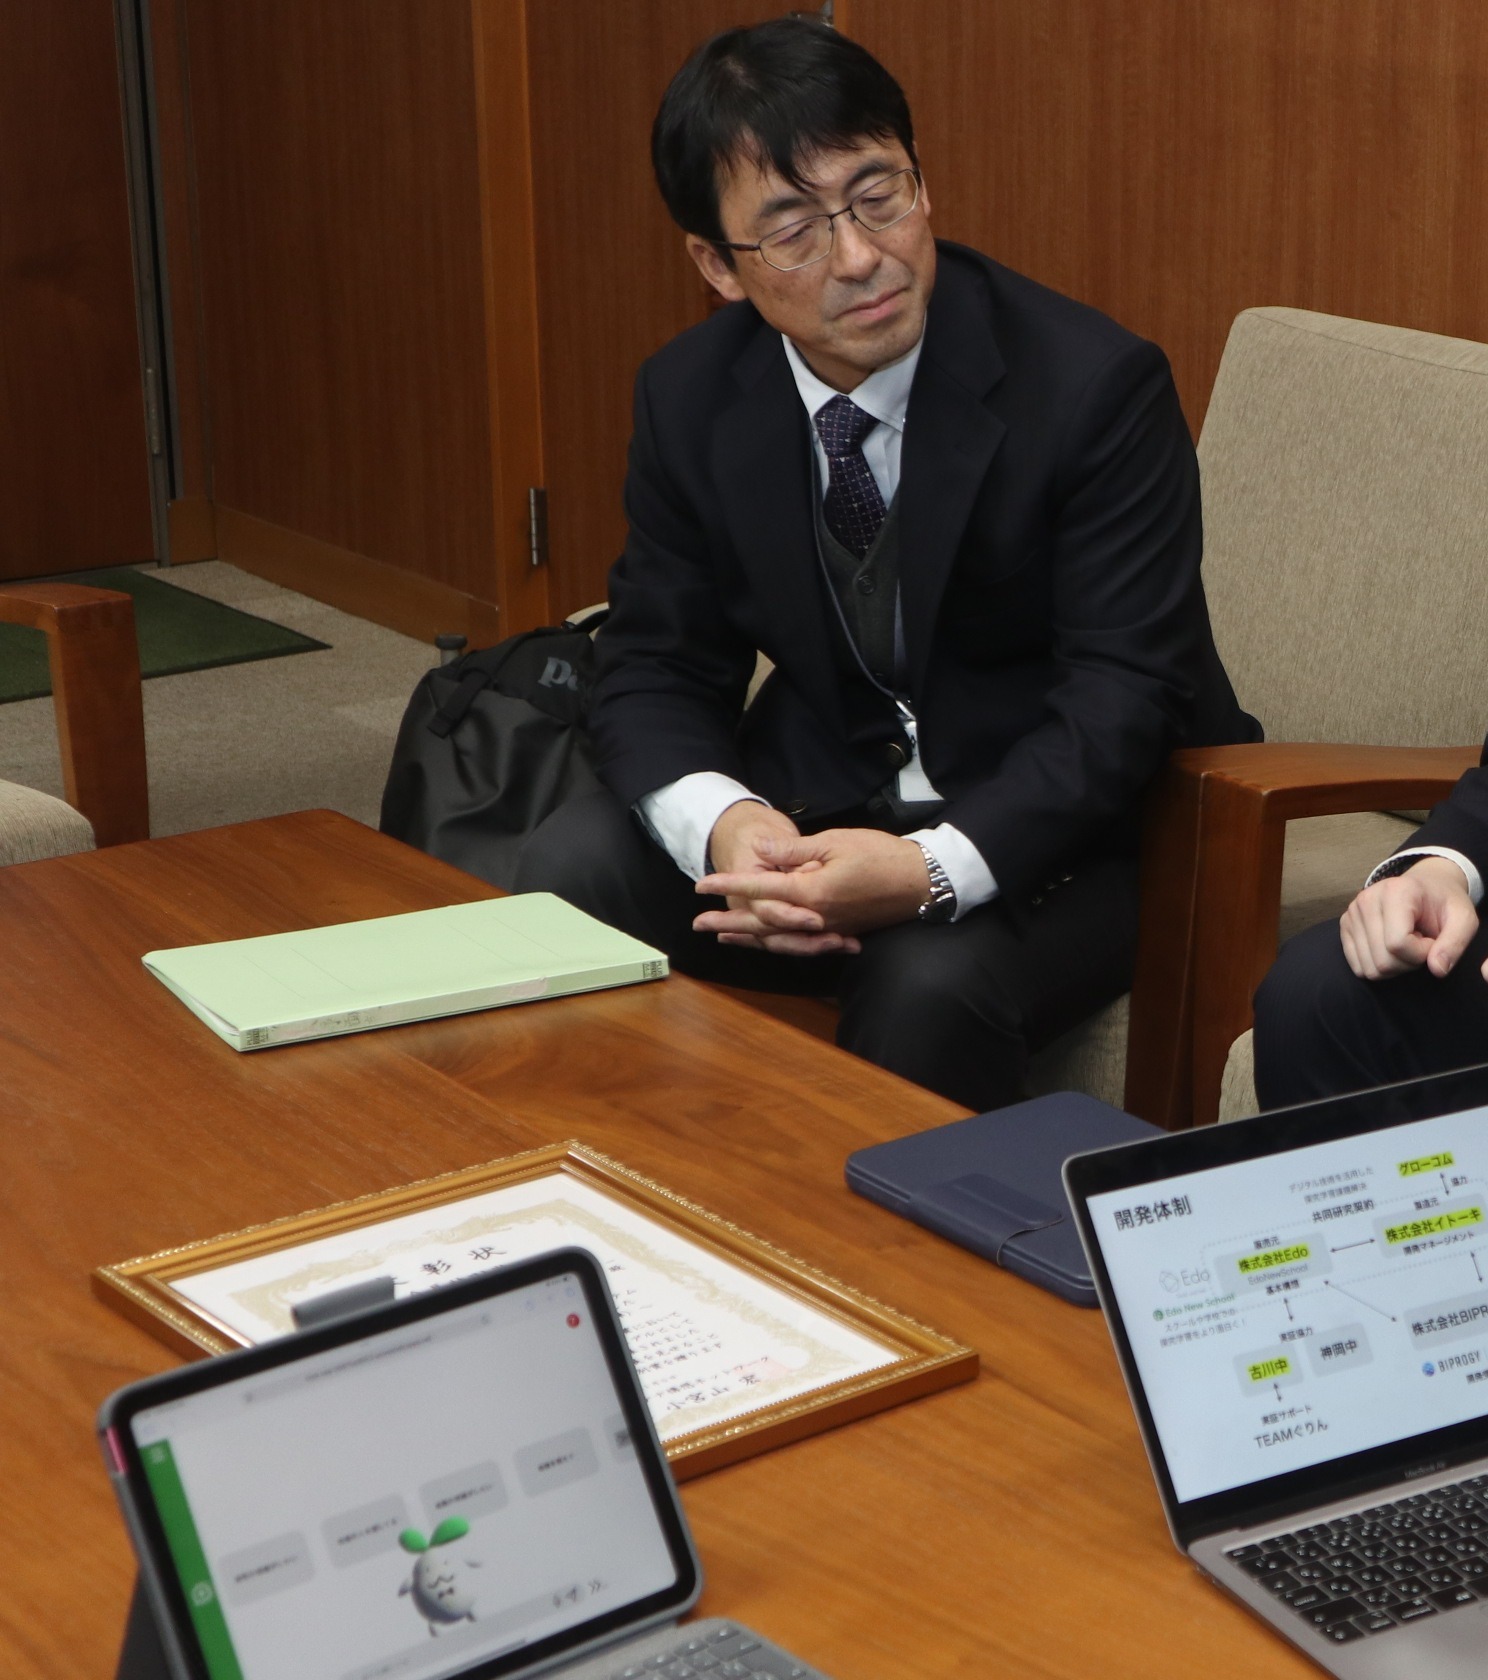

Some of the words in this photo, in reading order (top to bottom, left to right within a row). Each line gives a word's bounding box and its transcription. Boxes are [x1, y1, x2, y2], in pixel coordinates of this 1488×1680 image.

[1399, 1153, 1453, 1175] グローコム
[1114, 1196, 1193, 1230] 開発体制
[1312, 1199, 1375, 1223] 共同研究契約
[1385, 1208, 1482, 1243] 株式会社イトーキ
[1253, 1236, 1280, 1250] 販売元
[1403, 1231, 1474, 1255] 開発マネージメント
[1238, 1246, 1309, 1273] 株式会社Edo
[1181, 1267, 1210, 1287] Edo
[1248, 1263, 1309, 1285] EdoNewSchool
[1165, 1306, 1182, 1318] Edo
[1184, 1301, 1203, 1312] New
[1205, 1294, 1236, 1308] School
[1320, 1339, 1357, 1360] 神岡中
[1249, 1359, 1288, 1381] 古川中
[1438, 1350, 1481, 1373] BIPROGY
[1261, 1405, 1312, 1426] 実証サポート
[1254, 1419, 1328, 1449] TEAMぐりん
